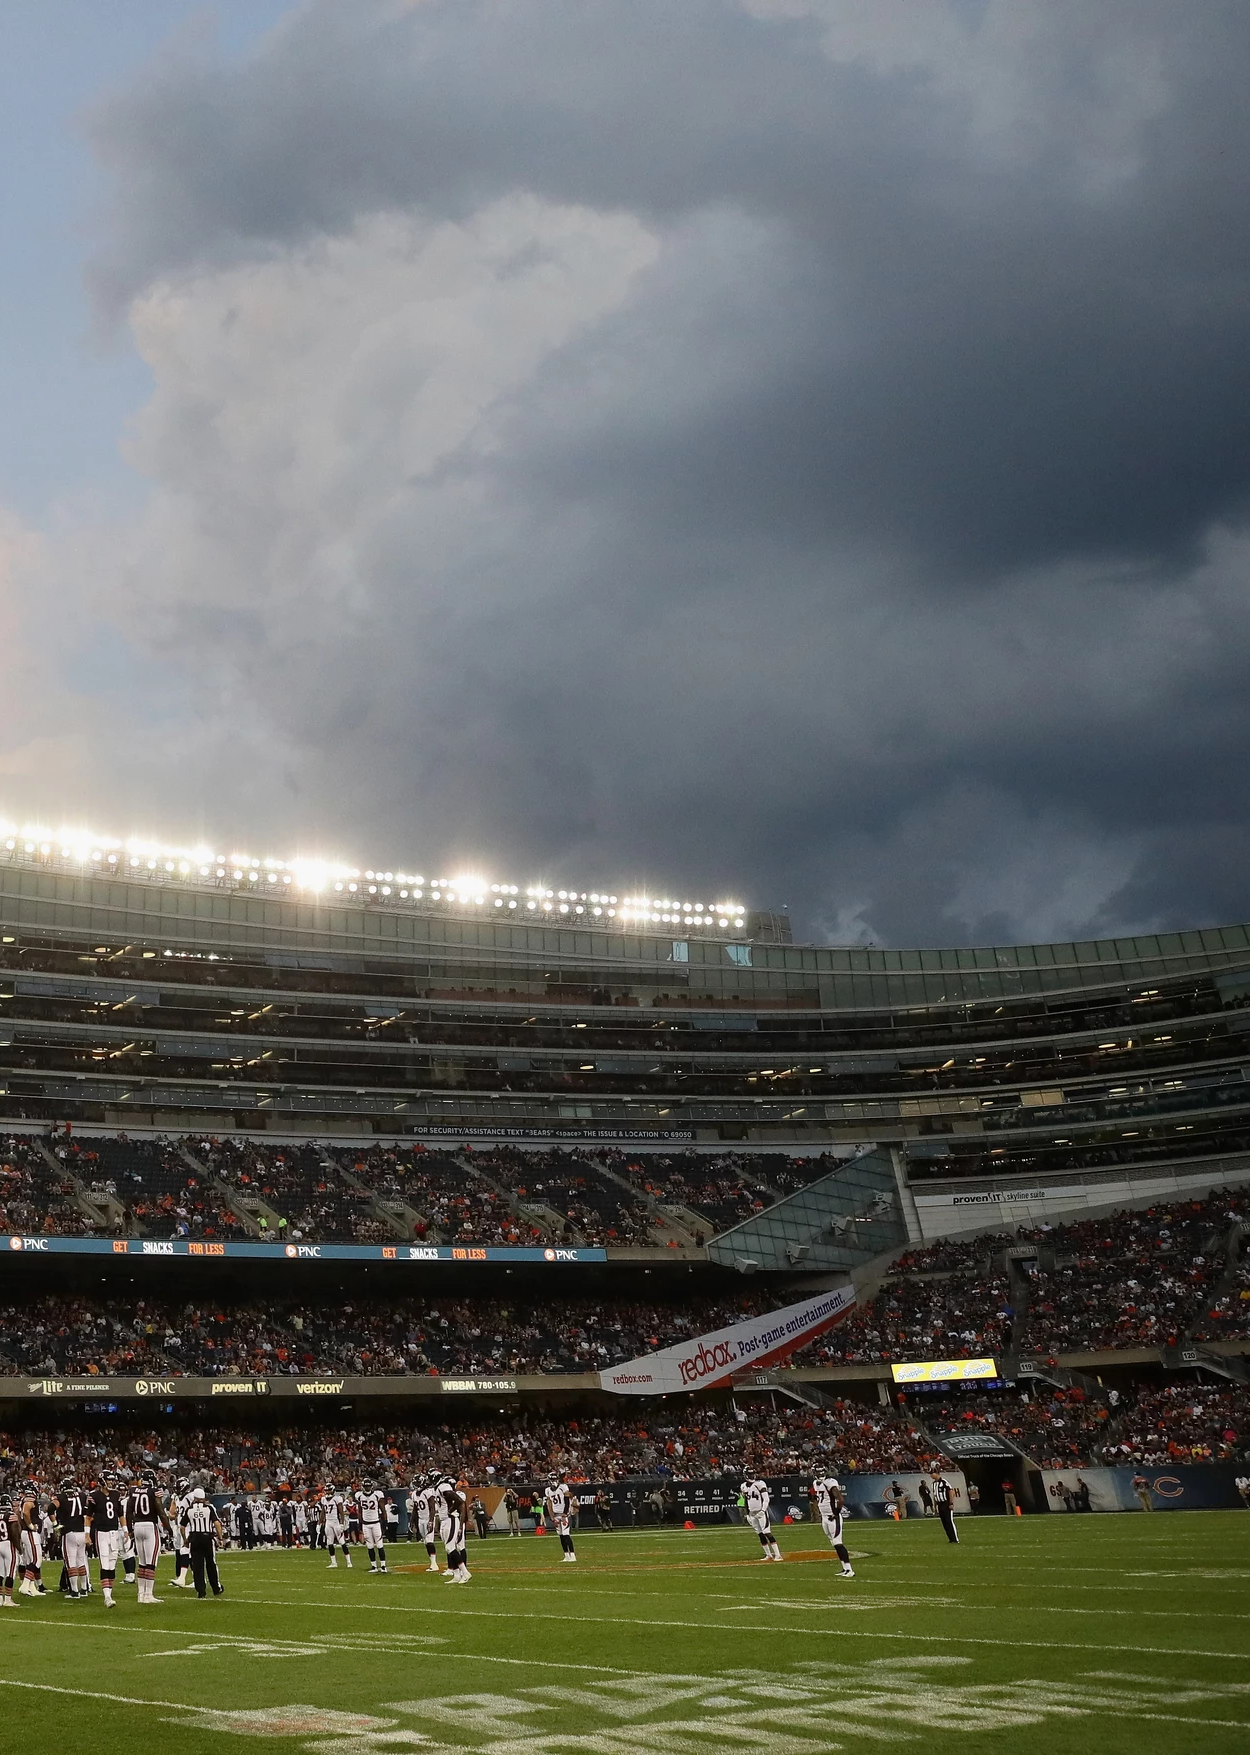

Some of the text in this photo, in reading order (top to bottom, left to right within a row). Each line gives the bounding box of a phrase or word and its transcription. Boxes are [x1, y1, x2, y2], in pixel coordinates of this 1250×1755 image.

[413, 1126, 428, 1134] FOR
[429, 1127, 506, 1135] SECURITY/ASSISTANCE
[506, 1128, 524, 1136] TEXT
[953, 1194, 989, 1205] proven
[1006, 1192, 1029, 1201] skyline
[1030, 1190, 1046, 1198] suite
[23, 1238, 48, 1250] PNC
[112, 1241, 224, 1255] GET SNACKS FOR LESS
[298, 1246, 322, 1257] PNC
[382, 1247, 486, 1260] GET SNACKS FOR LESS
[555, 1250, 578, 1260] PNC
[738, 1324, 786, 1357] Post-game
[1183, 1352, 1196, 1360] 120
[897, 1367, 926, 1380] Snapple
[930, 1365, 958, 1380] Snapple
[963, 1363, 992, 1378] Snapple
[1020, 1363, 1033, 1372] 119
[612, 1373, 653, 1385] redbox.com
[756, 1376, 766, 1384] 117
[42, 1380, 64, 1396] Lite
[149, 1382, 176, 1394] PNC
[212, 1382, 253, 1395] proven
[296, 1380, 341, 1394] verizon
[441, 1380, 476, 1391] WBBM
[132, 1493, 150, 1516] 70
[362, 1500, 376, 1510] 52
[552, 1494, 562, 1504] 31
[68, 1496, 82, 1517] 71
[106, 1502, 114, 1520] 8
[252, 1504, 260, 1512] 70
[684, 1504, 720, 1514] RETIRED
